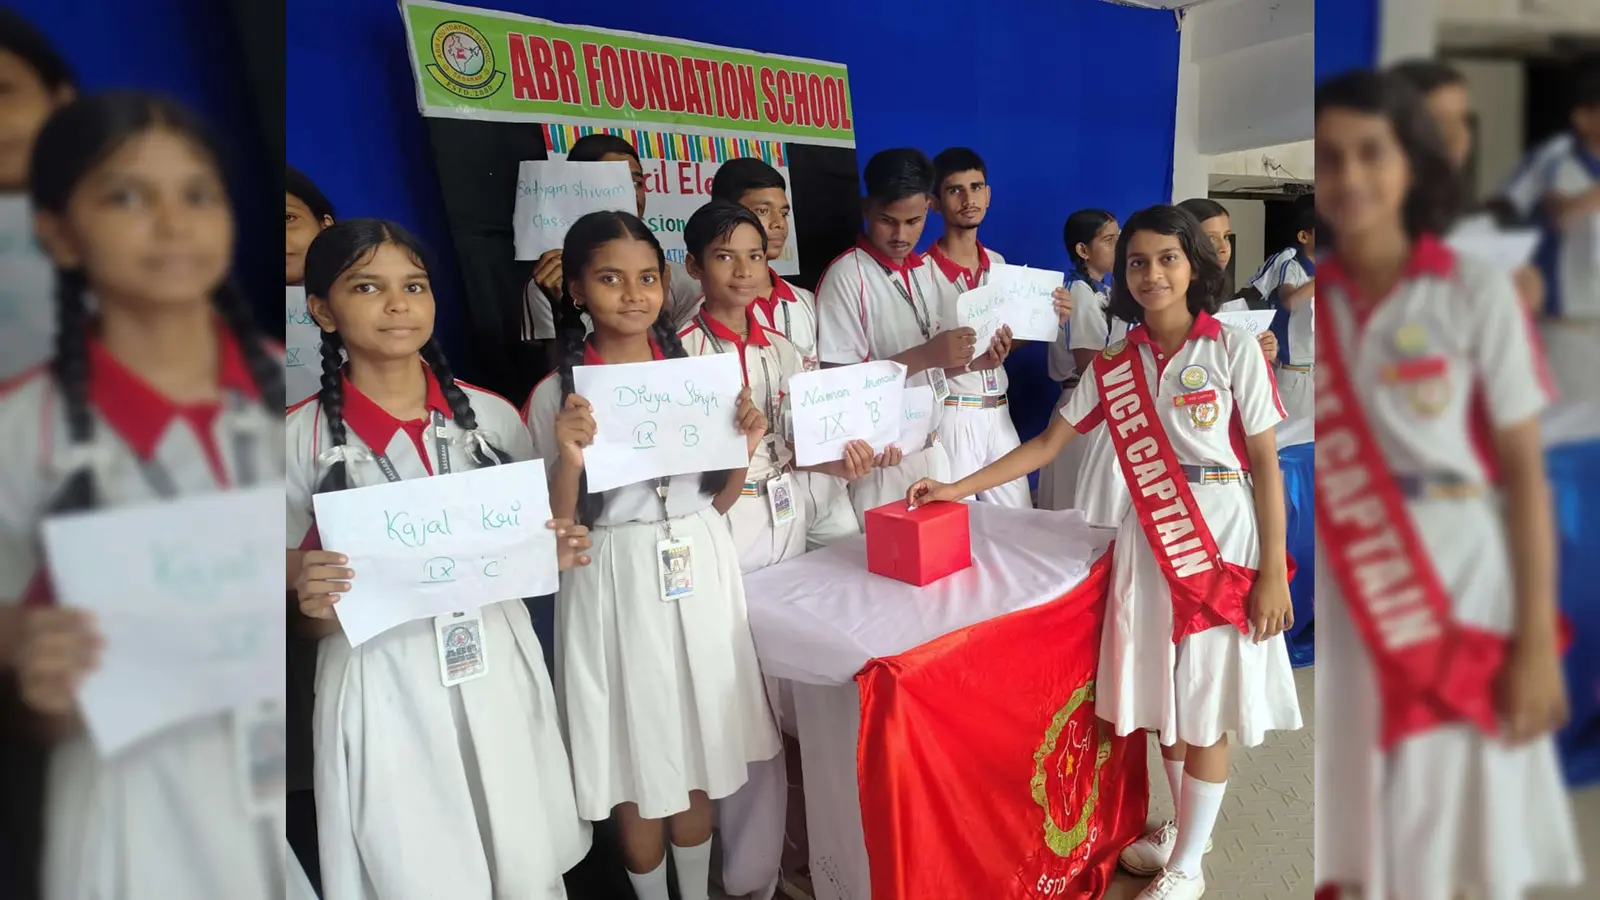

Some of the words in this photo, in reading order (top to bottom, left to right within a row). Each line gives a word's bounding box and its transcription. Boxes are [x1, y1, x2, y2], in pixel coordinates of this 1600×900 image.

[508, 33, 581, 104] ABR
[582, 43, 758, 121] FOUNDATION
[761, 67, 852, 130] SCHOOL
[641, 160, 670, 194] cil
[648, 214, 686, 233] sion
[613, 385, 671, 413] Divya
[676, 380, 719, 416] Singh
[801, 386, 851, 408] Naman
[679, 424, 699, 447] B
[817, 410, 853, 445] IX
[1101, 359, 1141, 440] VICE
[1126, 437, 1214, 578] CAPTAIN
[384, 509, 452, 548] Kajal
